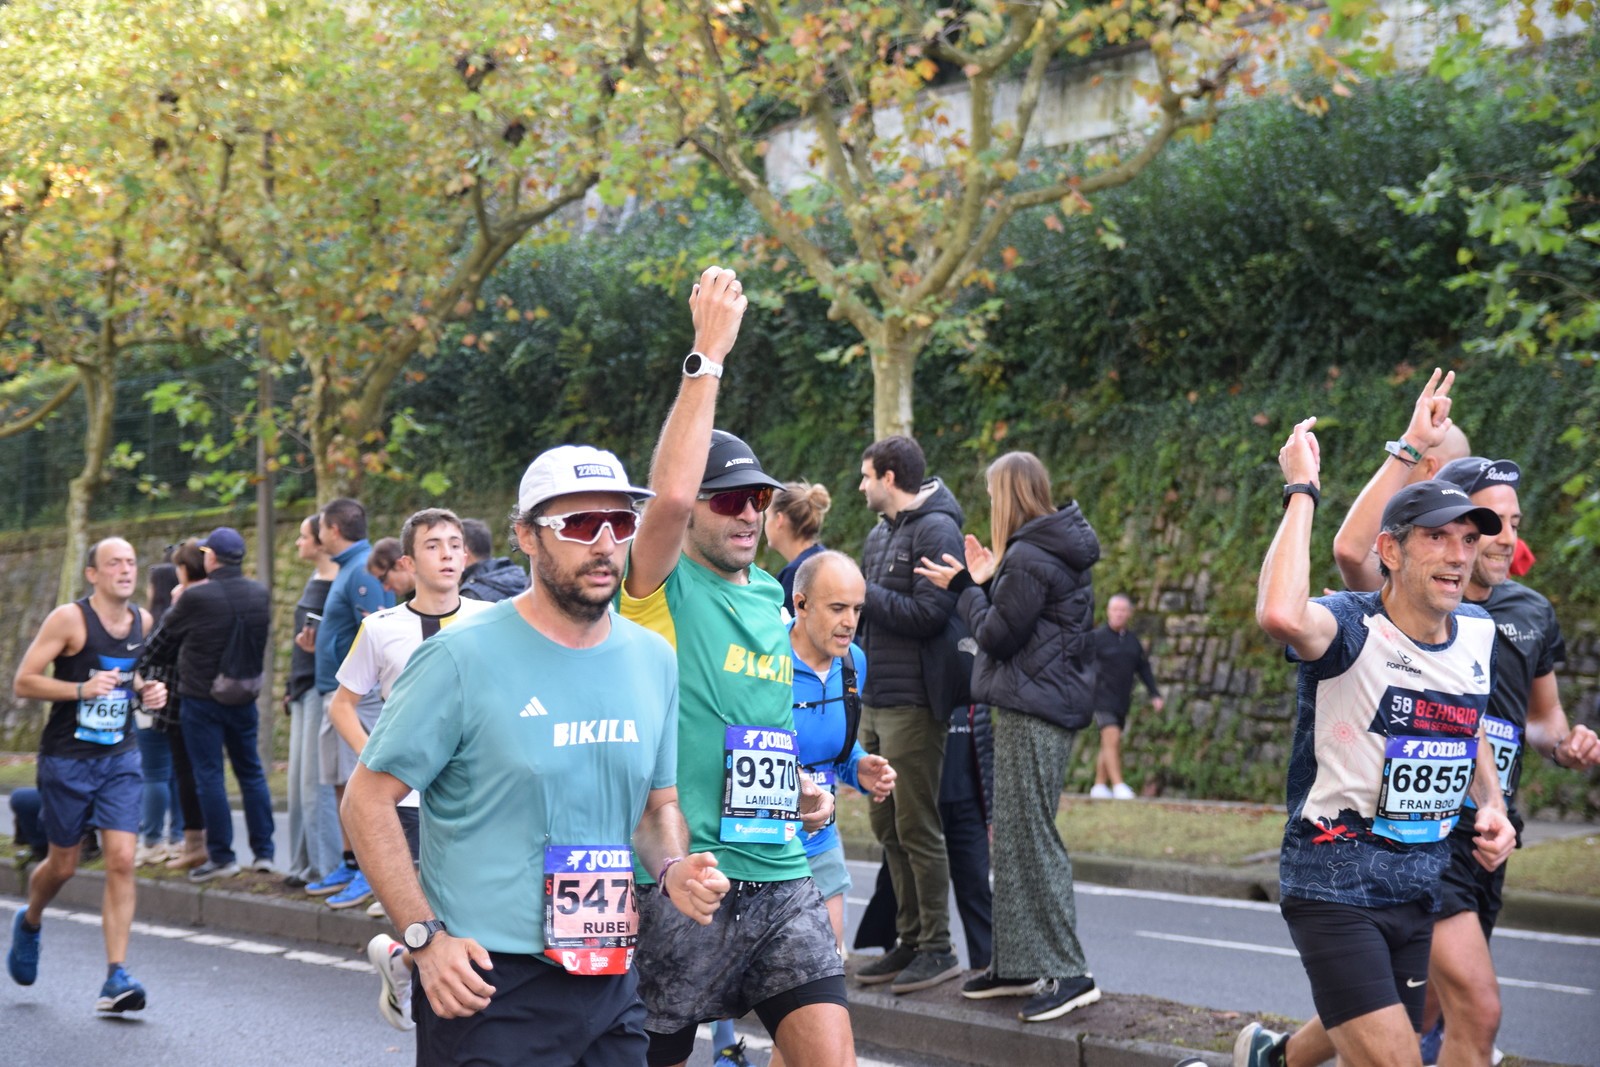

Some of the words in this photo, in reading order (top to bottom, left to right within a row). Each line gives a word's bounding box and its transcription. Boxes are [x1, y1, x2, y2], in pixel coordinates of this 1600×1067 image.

[1441, 489, 1469, 499] KIP
[723, 644, 792, 686] BIKIL
[1386, 661, 1422, 674] FORTUNA
[1391, 695, 1412, 714] 58
[1415, 699, 1477, 724] BEHOBIA
[553, 719, 640, 747] BIKILA
[1413, 718, 1429, 729] SAN
[1480, 718, 1514, 740] oma
[1418, 741, 1468, 758] Joma
[1491, 743, 1513, 772] 5
[736, 756, 796, 791] 9370
[1384, 763, 1390, 776] 6
[1392, 764, 1469, 794] 6855
[1400, 799, 1432, 809] FRAN
[585, 850, 631, 871] Jom
[546, 880, 553, 895] 5
